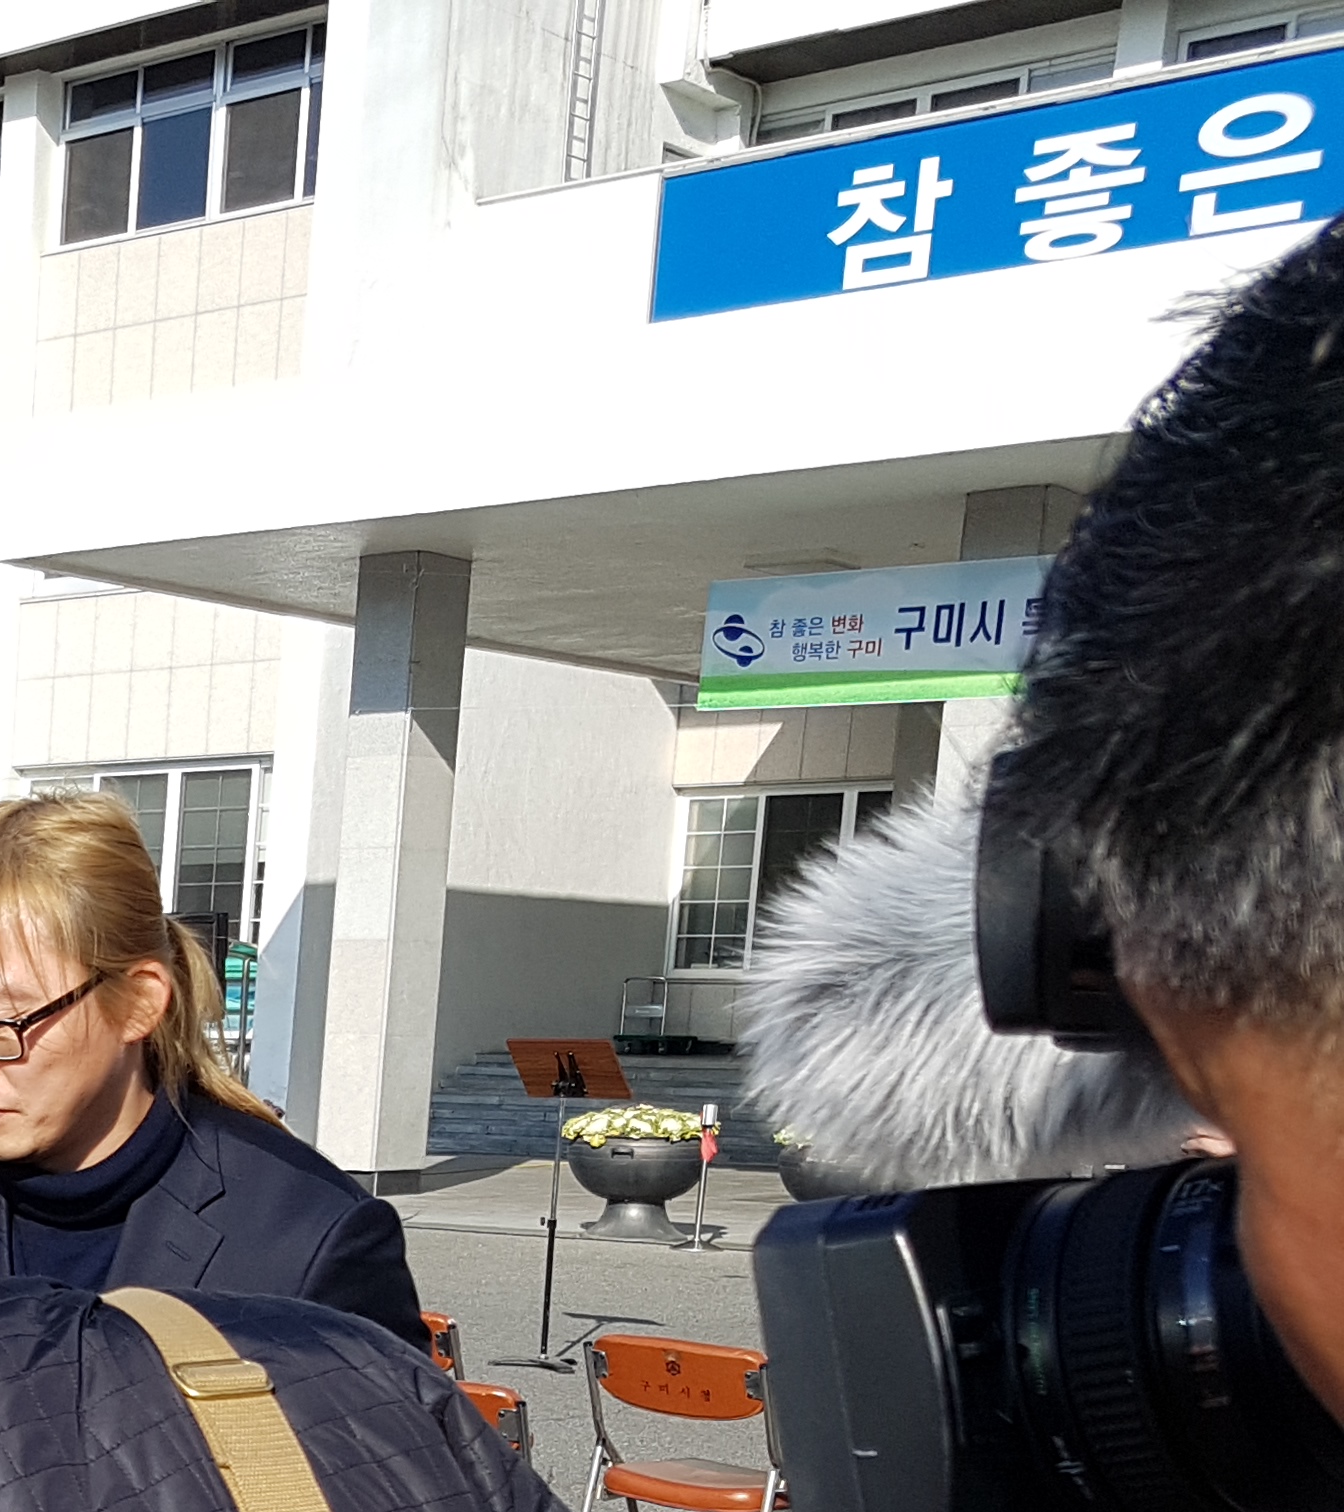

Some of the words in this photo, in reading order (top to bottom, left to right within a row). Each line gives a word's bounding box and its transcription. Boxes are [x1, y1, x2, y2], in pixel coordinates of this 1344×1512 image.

[826, 155, 954, 291] 참
[1015, 91, 1326, 264] 좋은
[768, 618, 786, 639] 참
[791, 617, 825, 638] 좋은
[831, 613, 865, 636] 변화
[894, 599, 1006, 651] 구미시
[791, 640, 841, 662] 행복한
[846, 637, 883, 659] 구미
